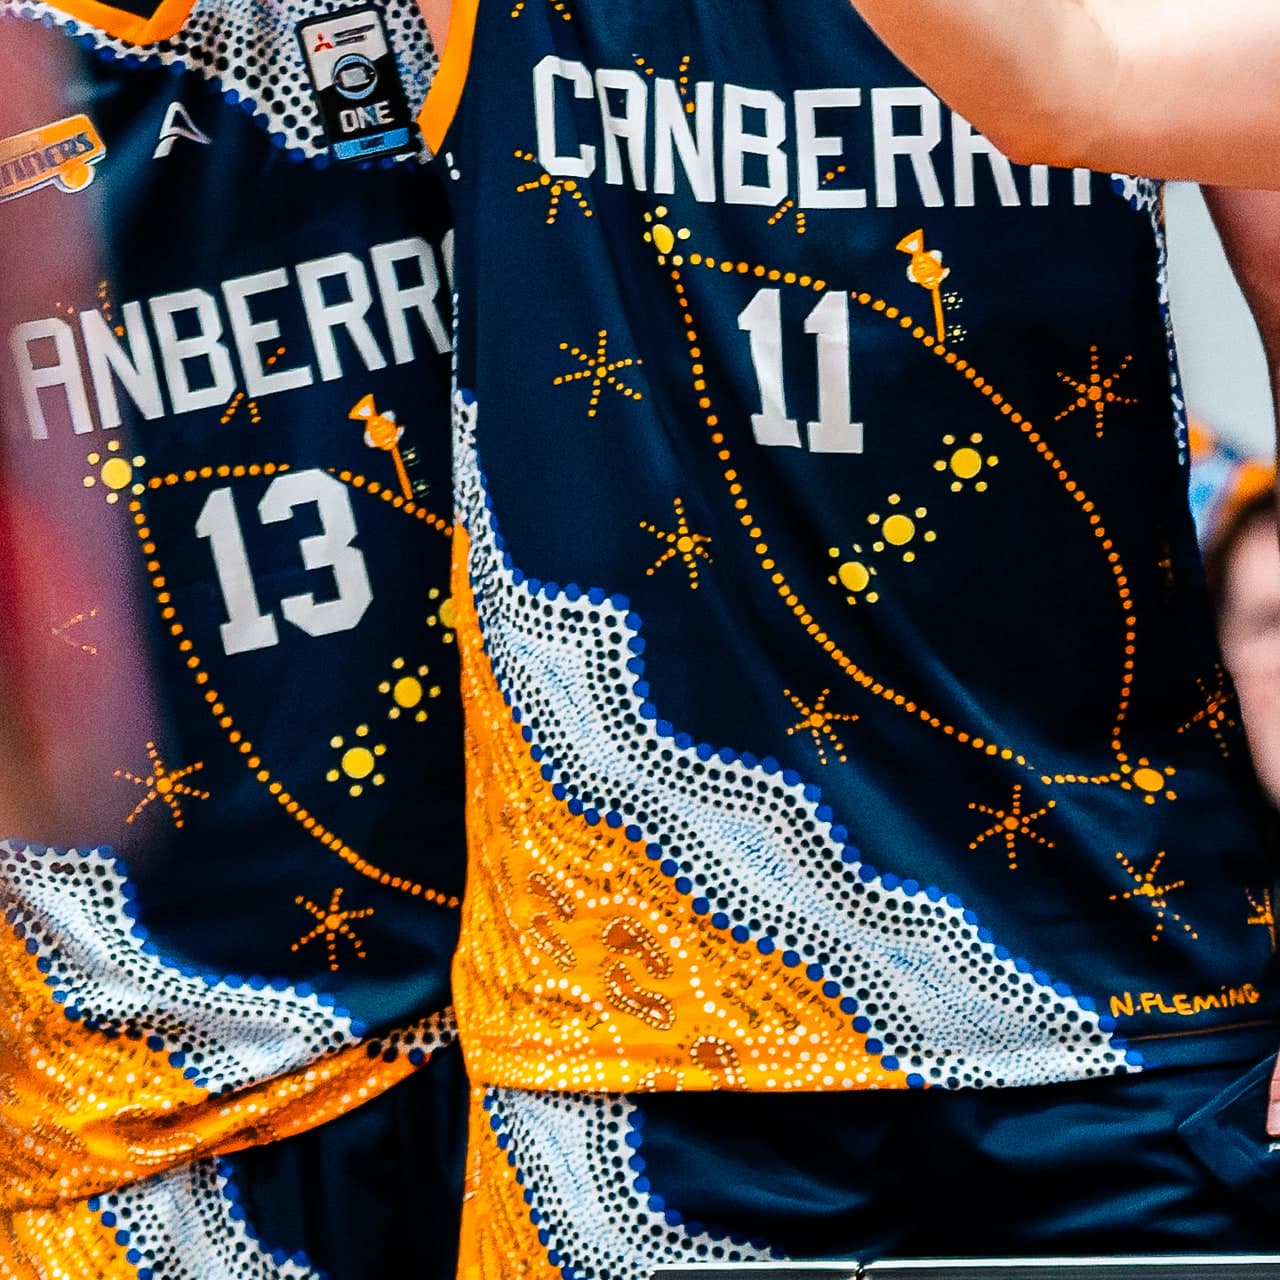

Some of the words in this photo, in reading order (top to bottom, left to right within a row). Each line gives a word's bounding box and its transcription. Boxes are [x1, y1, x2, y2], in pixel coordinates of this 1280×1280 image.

[339, 100, 395, 133] ONE
[532, 55, 1092, 210] CANBERR
[8, 228, 455, 441] ANBERR
[737, 287, 864, 454] 11
[195, 467, 376, 655] 13
